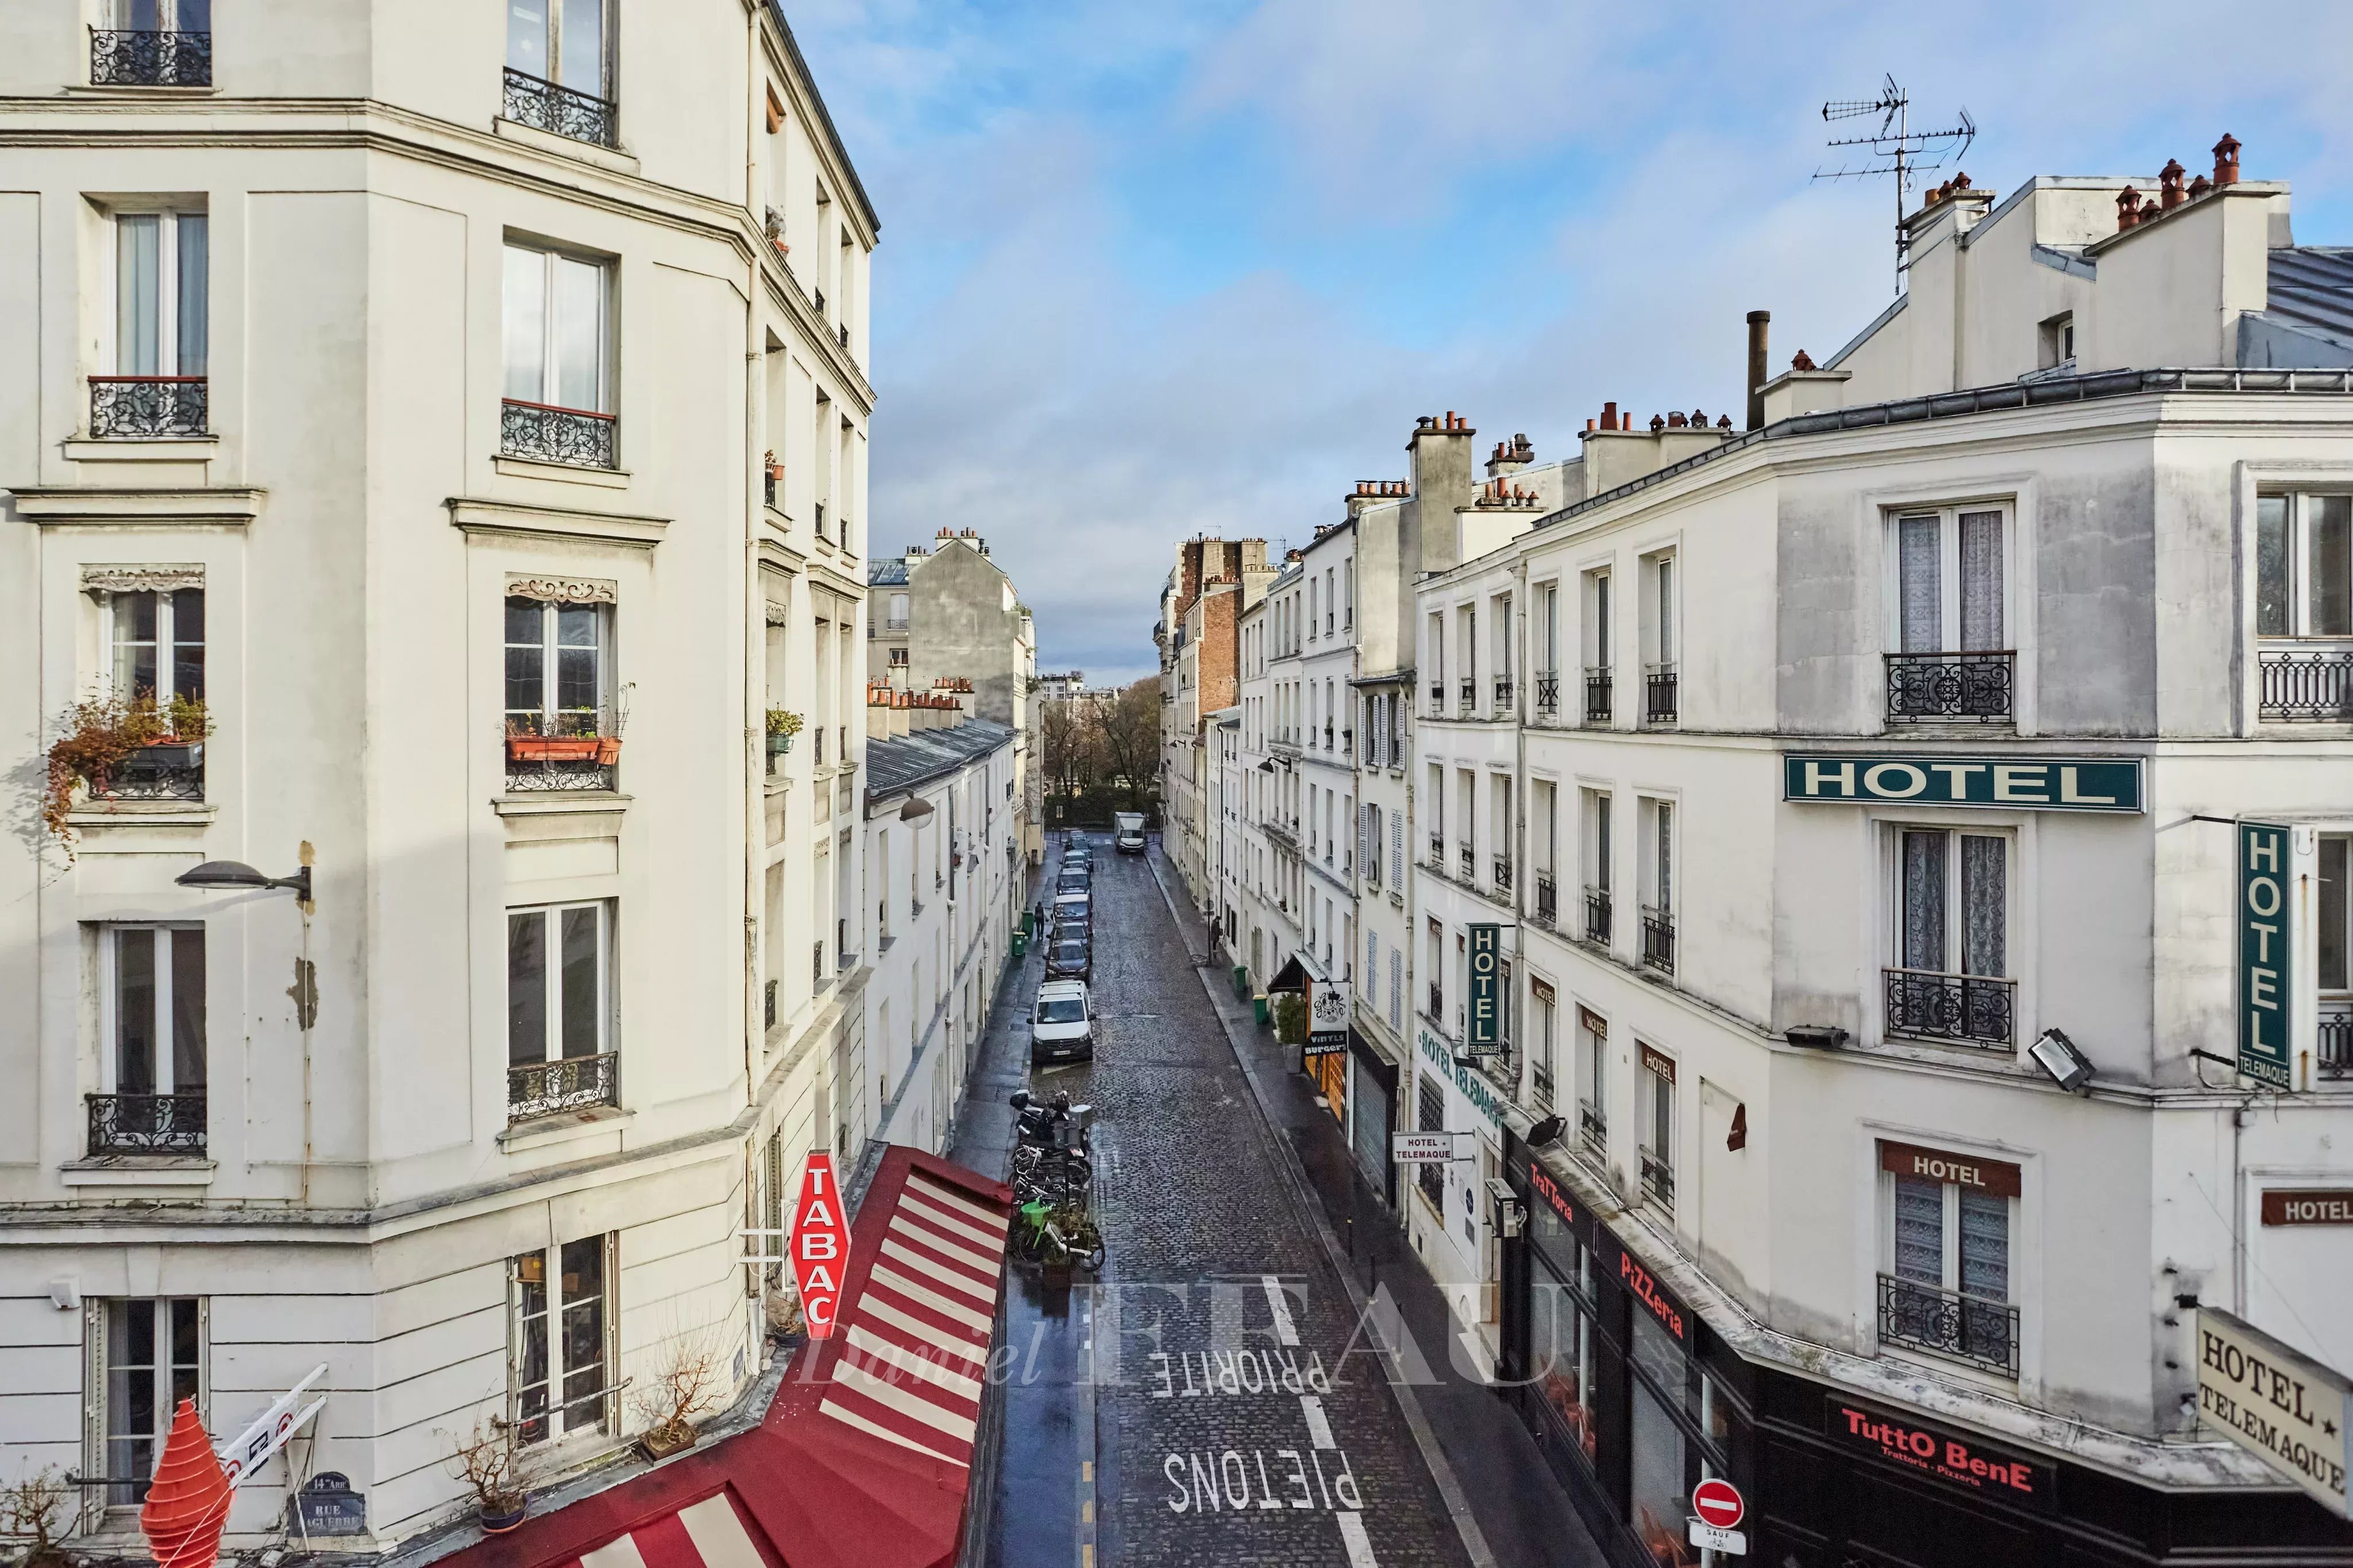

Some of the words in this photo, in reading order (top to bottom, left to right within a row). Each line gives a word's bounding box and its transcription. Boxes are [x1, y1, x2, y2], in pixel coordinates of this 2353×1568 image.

[1804, 762, 2116, 804] HOTEL
[2248, 831, 2281, 1055] HOTEL
[1474, 930, 1494, 1041] HOTEL
[1536, 984, 1556, 1006] HOTEL
[1586, 1015, 1607, 1039] HOTEL
[1422, 1030, 1452, 1080] HOTEL
[1469, 1045, 1498, 1053] TELEMAQUE
[1646, 1052, 1673, 1081] HOTEL
[2239, 1055, 2289, 1087] TELEMAQUE
[1397, 1150, 1451, 1158] TELEMAQUE
[1407, 1138, 1438, 1146] HOTEL
[1913, 1156, 1985, 1187] HOTEL
[2285, 1201, 2353, 1221] HOTEL
[801, 1168, 838, 1324] TABAC
[1150, 1350, 1332, 1397] PRIORITE
[2202, 1330, 2315, 1427] HOTEL
[2199, 1382, 2347, 1496] TELEMAQUE
[1164, 1449, 1364, 1513] PIETONS
[1880, 1445, 1928, 1469] Trattoria
[1937, 1465, 1981, 1487] Pizzeria
[315, 1505, 341, 1515] RUE
[1707, 1529, 1730, 1539] SAUF
